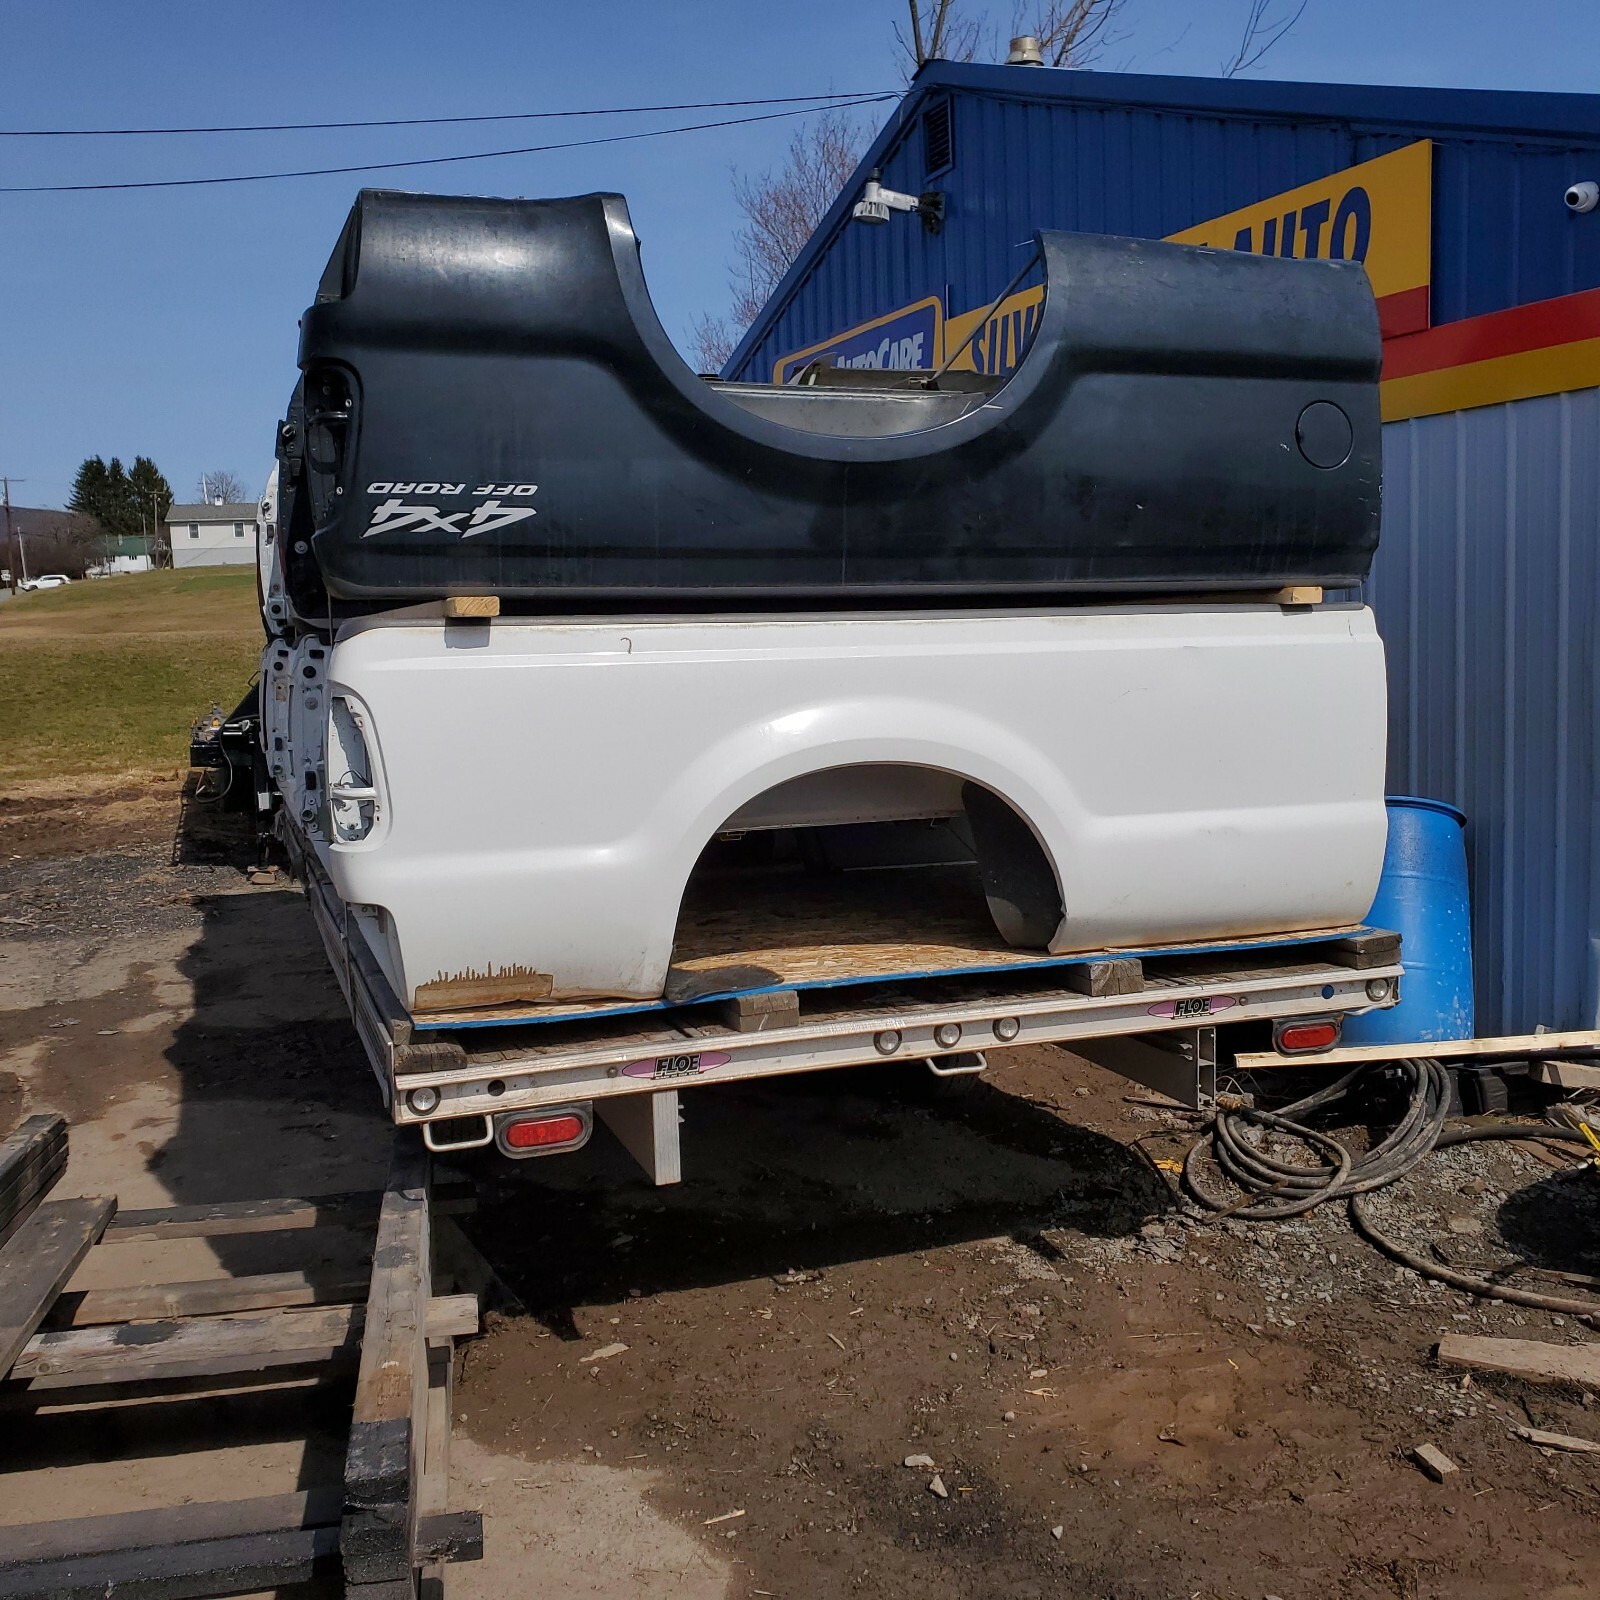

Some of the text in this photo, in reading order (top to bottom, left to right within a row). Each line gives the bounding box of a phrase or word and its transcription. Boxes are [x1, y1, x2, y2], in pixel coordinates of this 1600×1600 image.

[837, 331, 924, 370] OCARE
[971, 303, 1044, 377] SILV
[366, 482, 538, 496] OFF ROAD
[1174, 997, 1211, 1017] FLOE
[655, 1054, 701, 1077] FLOE
